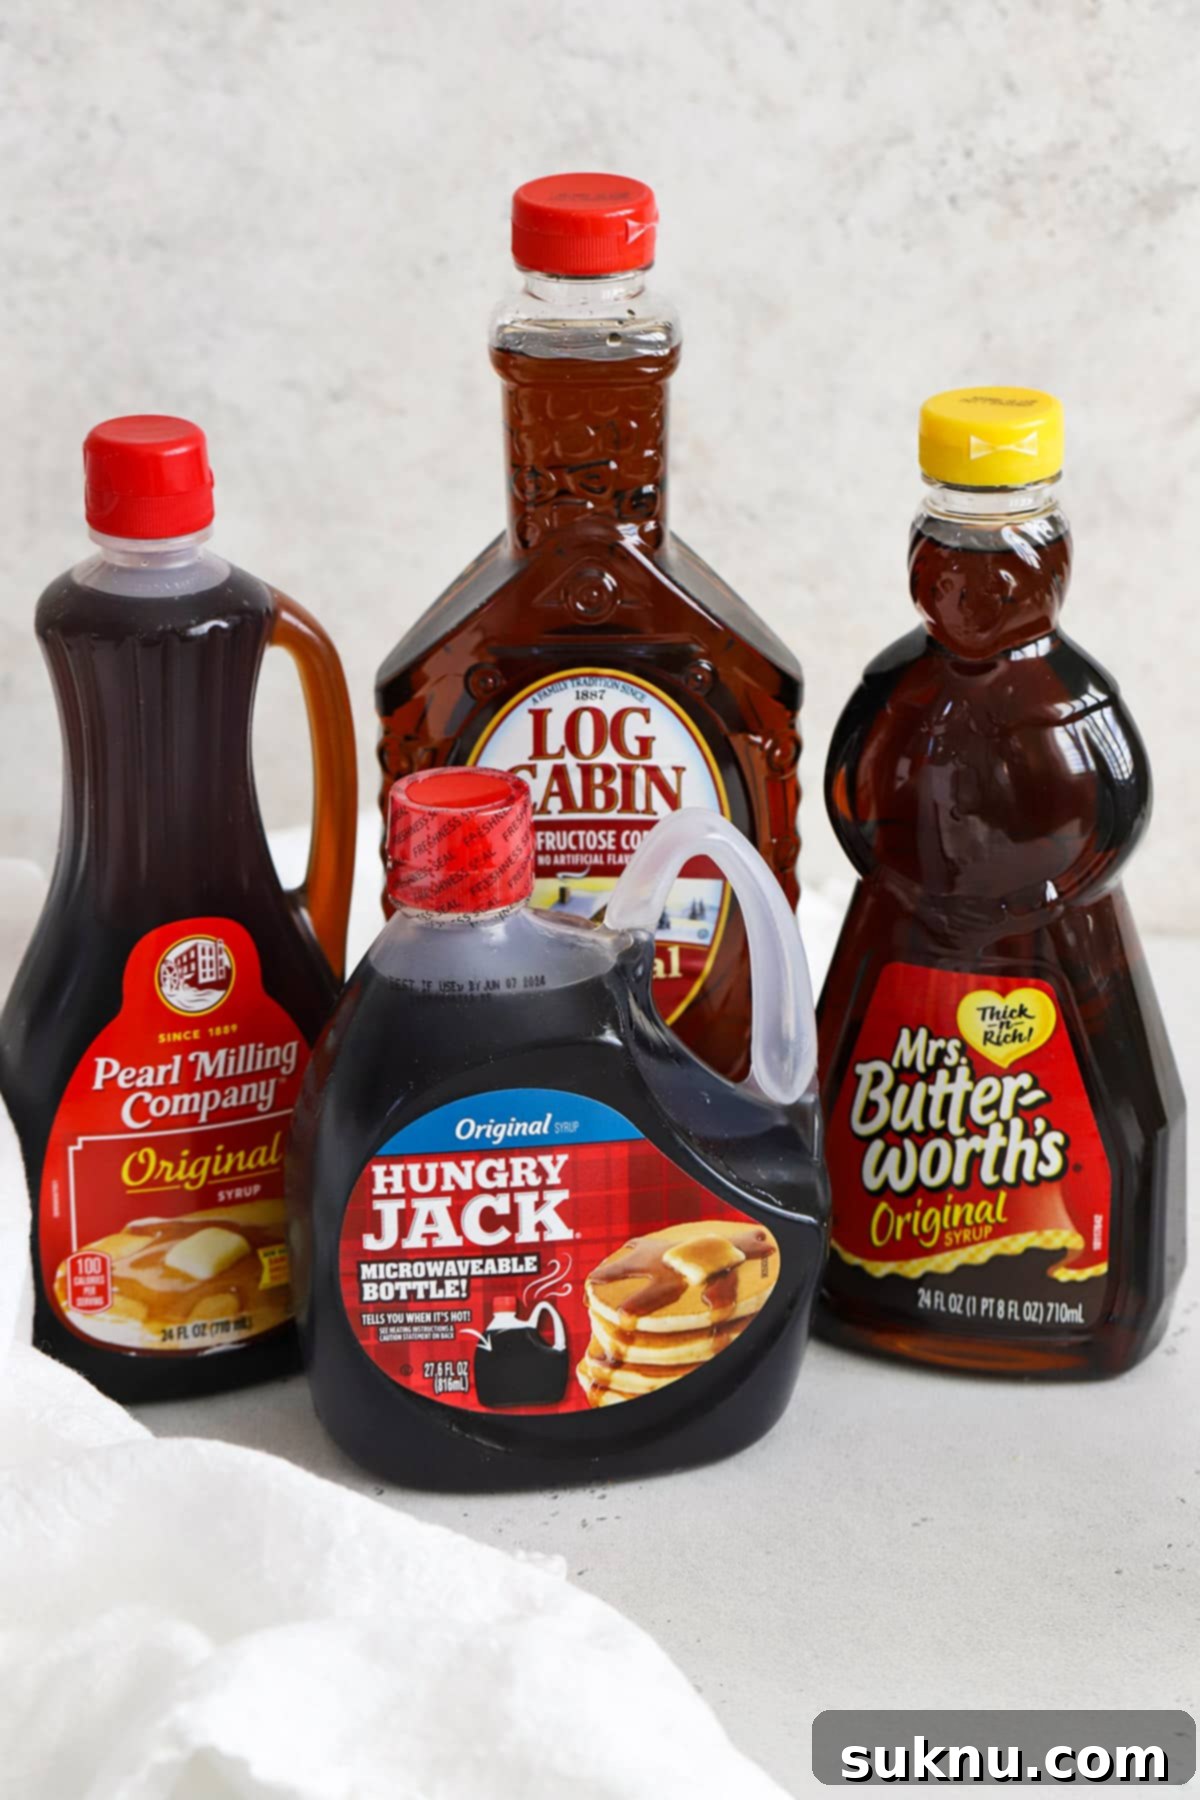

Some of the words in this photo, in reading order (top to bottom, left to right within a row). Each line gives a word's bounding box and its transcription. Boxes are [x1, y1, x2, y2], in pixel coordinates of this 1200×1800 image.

[570, 676, 619, 690] TRADITION
[620, 683, 647, 703] SINCE
[574, 690, 606, 700] 1887
[528, 706, 656, 760] LOG
[536, 830, 616, 851] FRUCTOSE
[537, 854, 551, 866] NO
[553, 853, 604, 866] ARTIFICIAL
[607, 853, 631, 865] FLAV
[422, 980, 432, 992] IF
[976, 1003, 1036, 1021] Thick
[158, 1029, 200, 1043] SINCE
[208, 1024, 238, 1038] 1889
[983, 1027, 1034, 1047] Rich!
[892, 1027, 968, 1073] Mrs.
[91, 1053, 182, 1090] Pearl
[188, 1040, 299, 1083] Milling
[121, 1078, 278, 1129] Company
[850, 1059, 1047, 1137] Butter-
[455, 1113, 552, 1145] Original
[554, 1121, 580, 1134] SYRUP
[121, 1131, 283, 1191] Original
[862, 1117, 1065, 1192] worth's
[371, 1154, 569, 1195] HUNGRY
[217, 1184, 262, 1202] SYRUP
[362, 1189, 574, 1251] JACK
[870, 1191, 1007, 1248] Original
[944, 1227, 993, 1248] SYRUP
[77, 1257, 102, 1275] 100
[360, 1256, 538, 1280] MICROWAVEABLE
[362, 1279, 468, 1301] BOTTLE!
[917, 1287, 931, 1310] 24
[934, 1290, 946, 1312] FL
[949, 1292, 964, 1315] OZ
[980, 1297, 995, 1319] PT
[997, 1299, 1005, 1320] 8
[1008, 1300, 1020, 1321] FL
[1023, 1299, 1043, 1325] OZ)
[1046, 1301, 1085, 1324] 710mL
[362, 1313, 385, 1325] TELLS
[386, 1312, 405, 1324] YOU
[406, 1311, 432, 1323] WHEN
[433, 1311, 449, 1322] IT'S
[450, 1310, 471, 1322] HOT!
[161, 1328, 174, 1342] 24
[176, 1326, 189, 1340] FL
[191, 1323, 207, 1338] OZ
[424, 1361, 443, 1378] 27.6
[444, 1361, 454, 1377] FL
[457, 1361, 468, 1376] OZ
[434, 1373, 469, 1394] (816mL)
